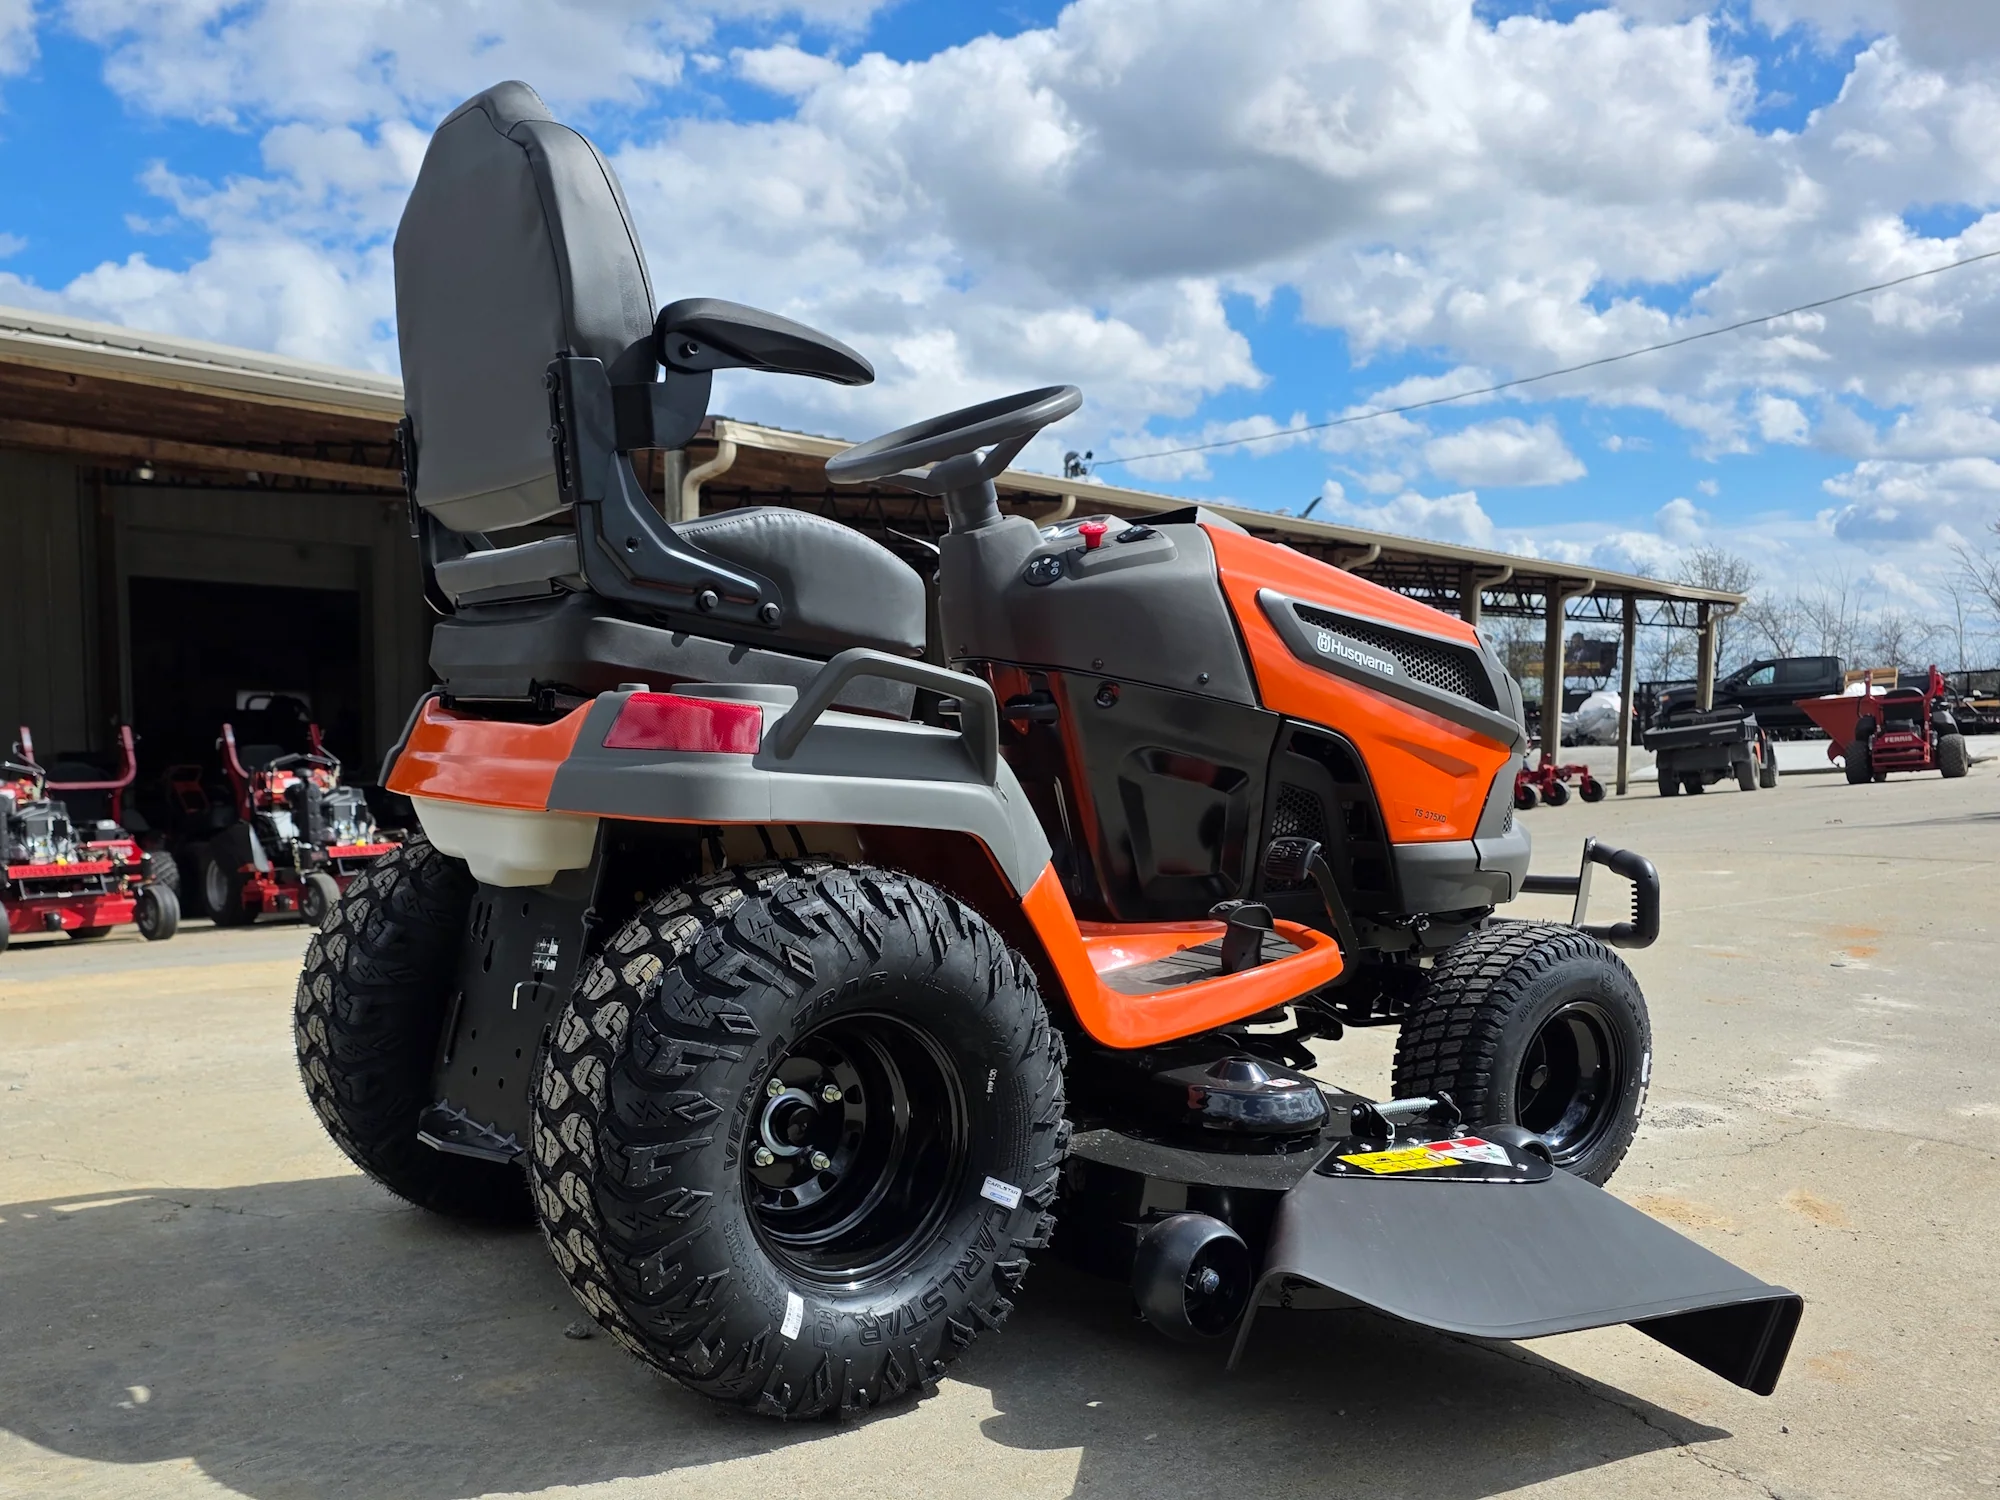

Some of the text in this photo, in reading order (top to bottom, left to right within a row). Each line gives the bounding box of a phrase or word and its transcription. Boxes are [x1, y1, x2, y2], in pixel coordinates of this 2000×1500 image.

[1331, 638, 1394, 676] Husqvarna
[1884, 735, 1913, 743] FERRIS
[1415, 808, 1447, 823] TS 375XD
[723, 1032, 790, 1172] VERSA
[985, 1179, 1019, 1196] CARLSTAR
[855, 1202, 1012, 1347] CARLSTAR
